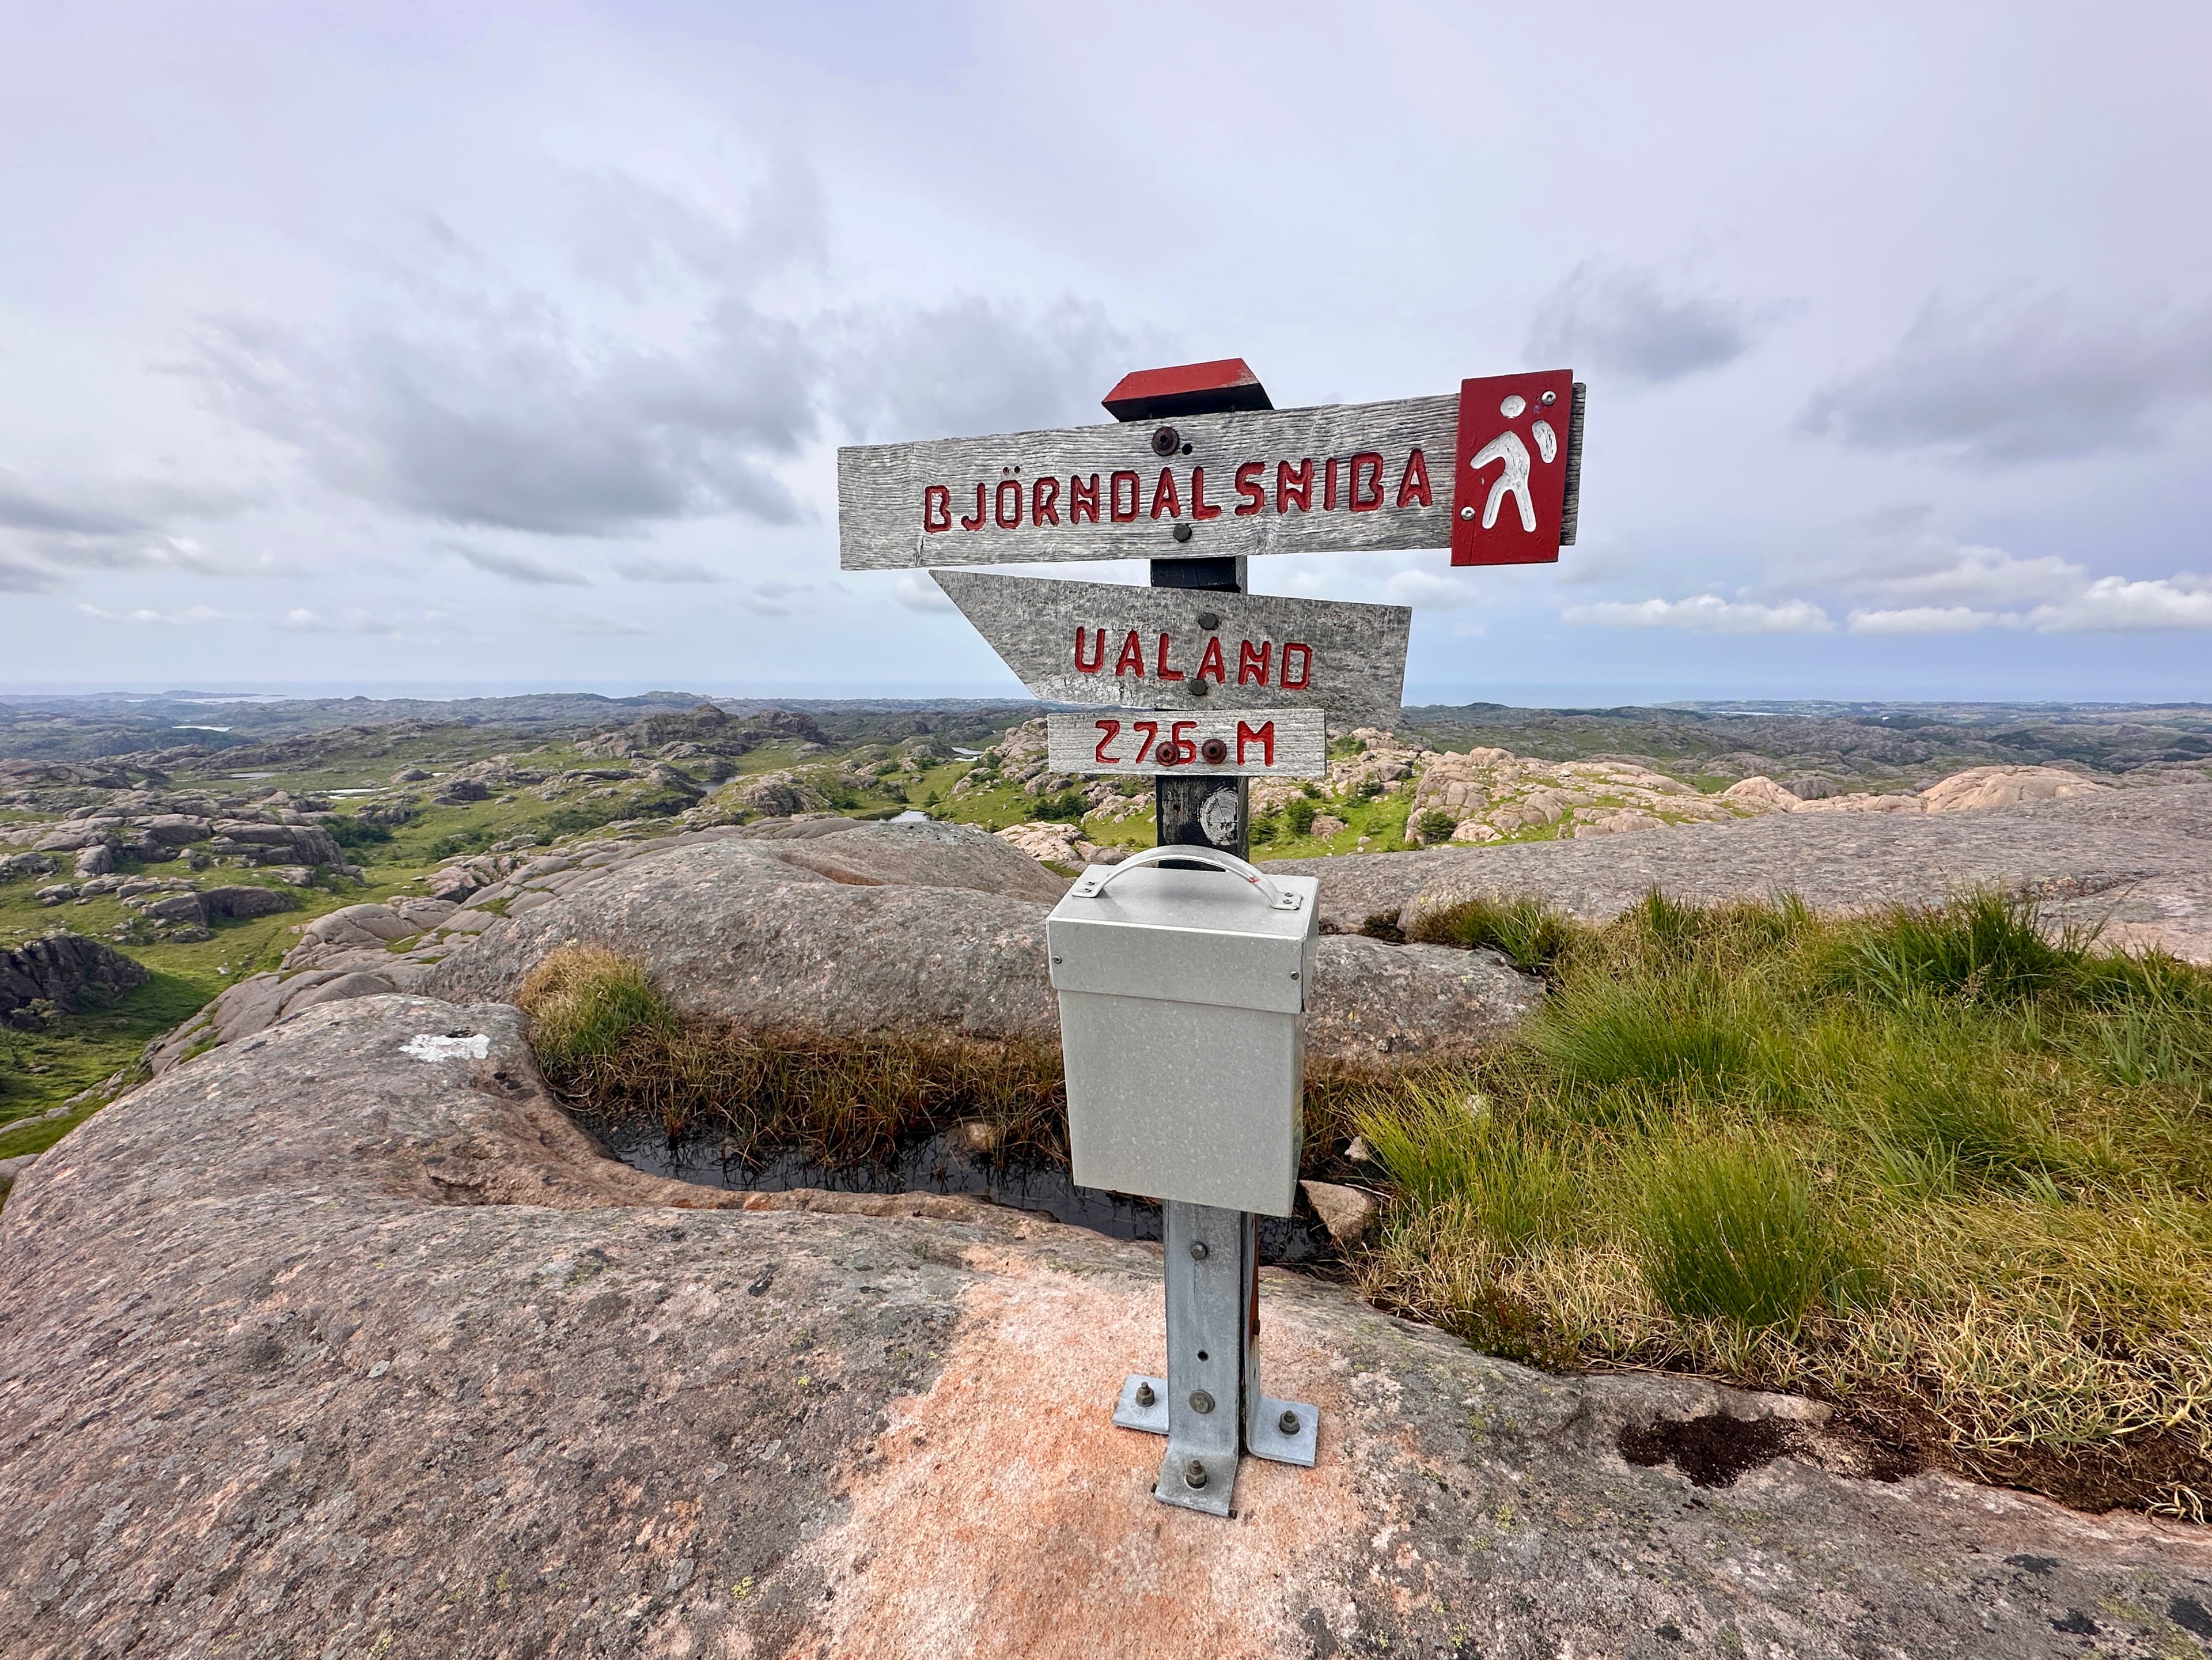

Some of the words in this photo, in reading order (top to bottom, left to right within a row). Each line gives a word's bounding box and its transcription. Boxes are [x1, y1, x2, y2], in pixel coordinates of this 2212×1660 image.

[925, 449, 1433, 534] BJÖRNDALSNIBA
[1074, 626, 1313, 690] UALAND
[1236, 720, 1275, 767] M
